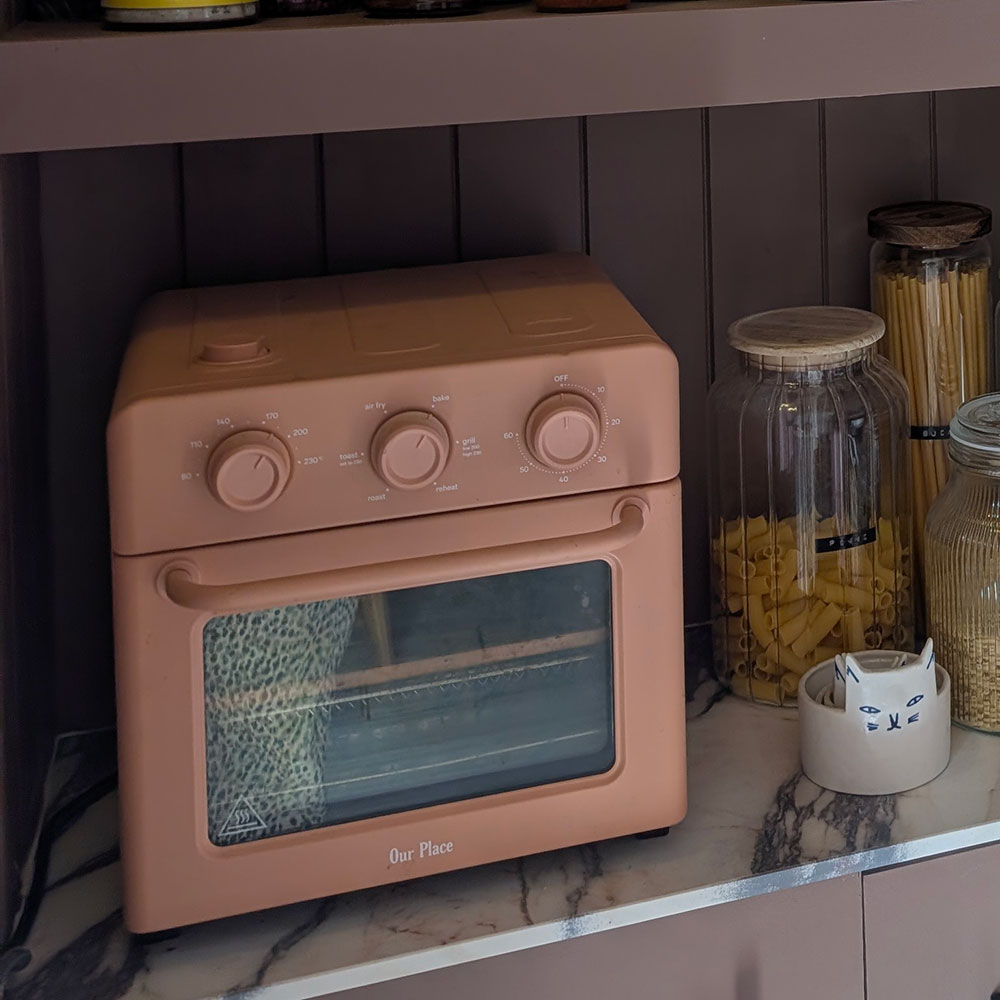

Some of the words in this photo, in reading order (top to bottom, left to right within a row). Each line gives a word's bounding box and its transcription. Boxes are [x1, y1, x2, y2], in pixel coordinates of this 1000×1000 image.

[554, 374, 568, 382] OFF
[375, 401, 386, 410] fry
[611, 418, 620, 426] 20
[293, 428, 308, 436] 200
[462, 437, 476, 446] grill
[339, 452, 358, 460] toast
[597, 455, 607, 463] 30
[519, 465, 529, 473] 50
[559, 475, 568, 483] 40
[435, 483, 458, 492] reheat
[389, 847, 414, 864] Our
[419, 840, 453, 858] Place
